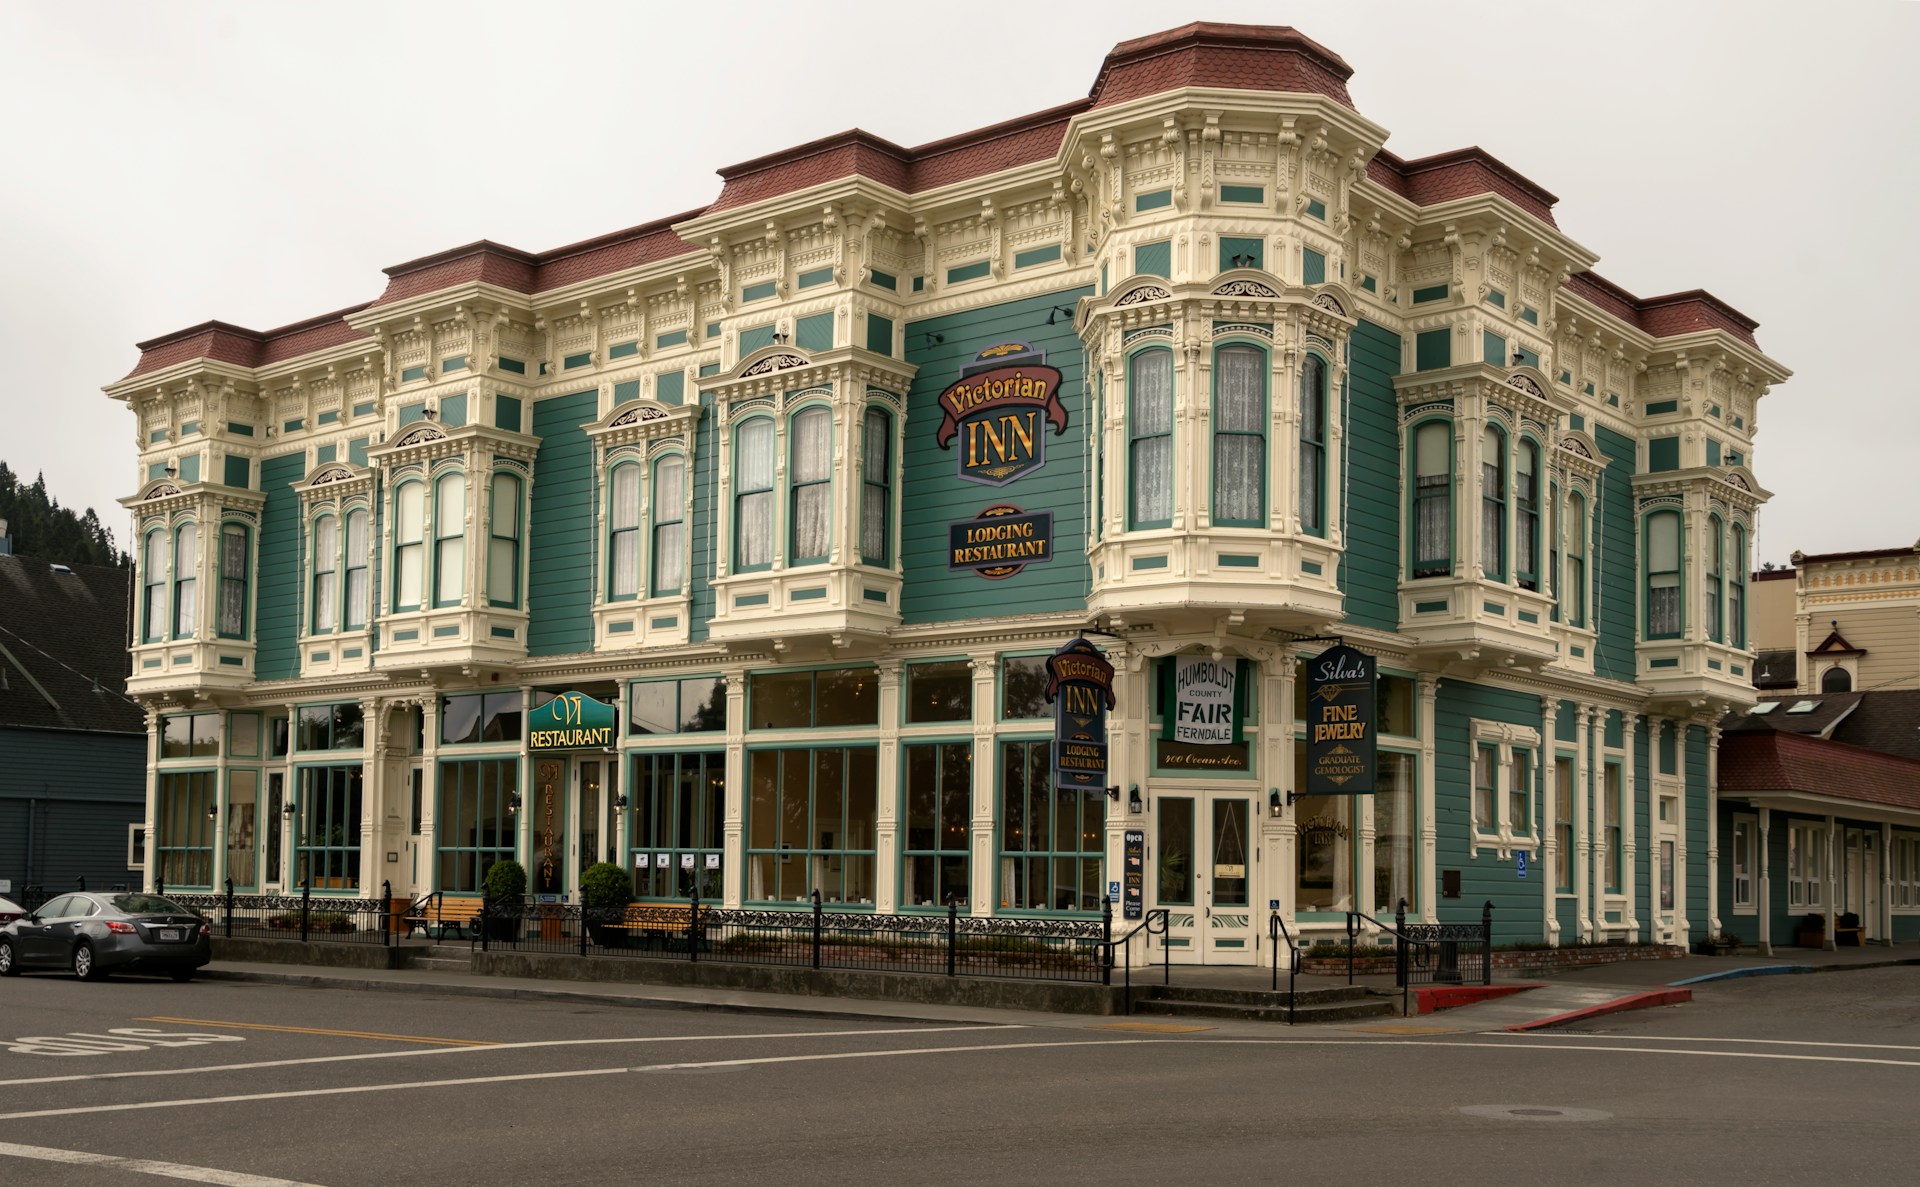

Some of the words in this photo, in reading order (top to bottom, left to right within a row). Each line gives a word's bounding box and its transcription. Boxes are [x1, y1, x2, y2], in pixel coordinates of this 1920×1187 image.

[947, 372, 1047, 413] Victorian
[966, 412, 1036, 468] INN
[967, 522, 1033, 543] LODGING
[954, 540, 1046, 563] RESTAURANT
[1058, 659, 1106, 684] Victorian
[1178, 662, 1234, 693] HUMBOLDT
[1315, 655, 1365, 681] Silva's
[1065, 685, 1099, 716] INN
[1190, 690, 1222, 698] COUNTY
[1179, 702, 1231, 724] FAIR
[1323, 705, 1358, 722] FINE
[531, 728, 611, 747] RESTAURANT
[1178, 726, 1230, 740] FERNDALE
[1314, 722, 1366, 744] JEWELRY
[1067, 745, 1099, 756] LODGING
[1185, 754, 1215, 764] Ocean
[1319, 756, 1360, 764] GRADUATE
[1060, 756, 1105, 768] RESTAURANT
[1315, 766, 1365, 774] GEMOLOGIST
[544, 784, 553, 888] RESTAURANT
[1126, 834, 1142, 842] Open
[1314, 832, 1331, 845] INN
